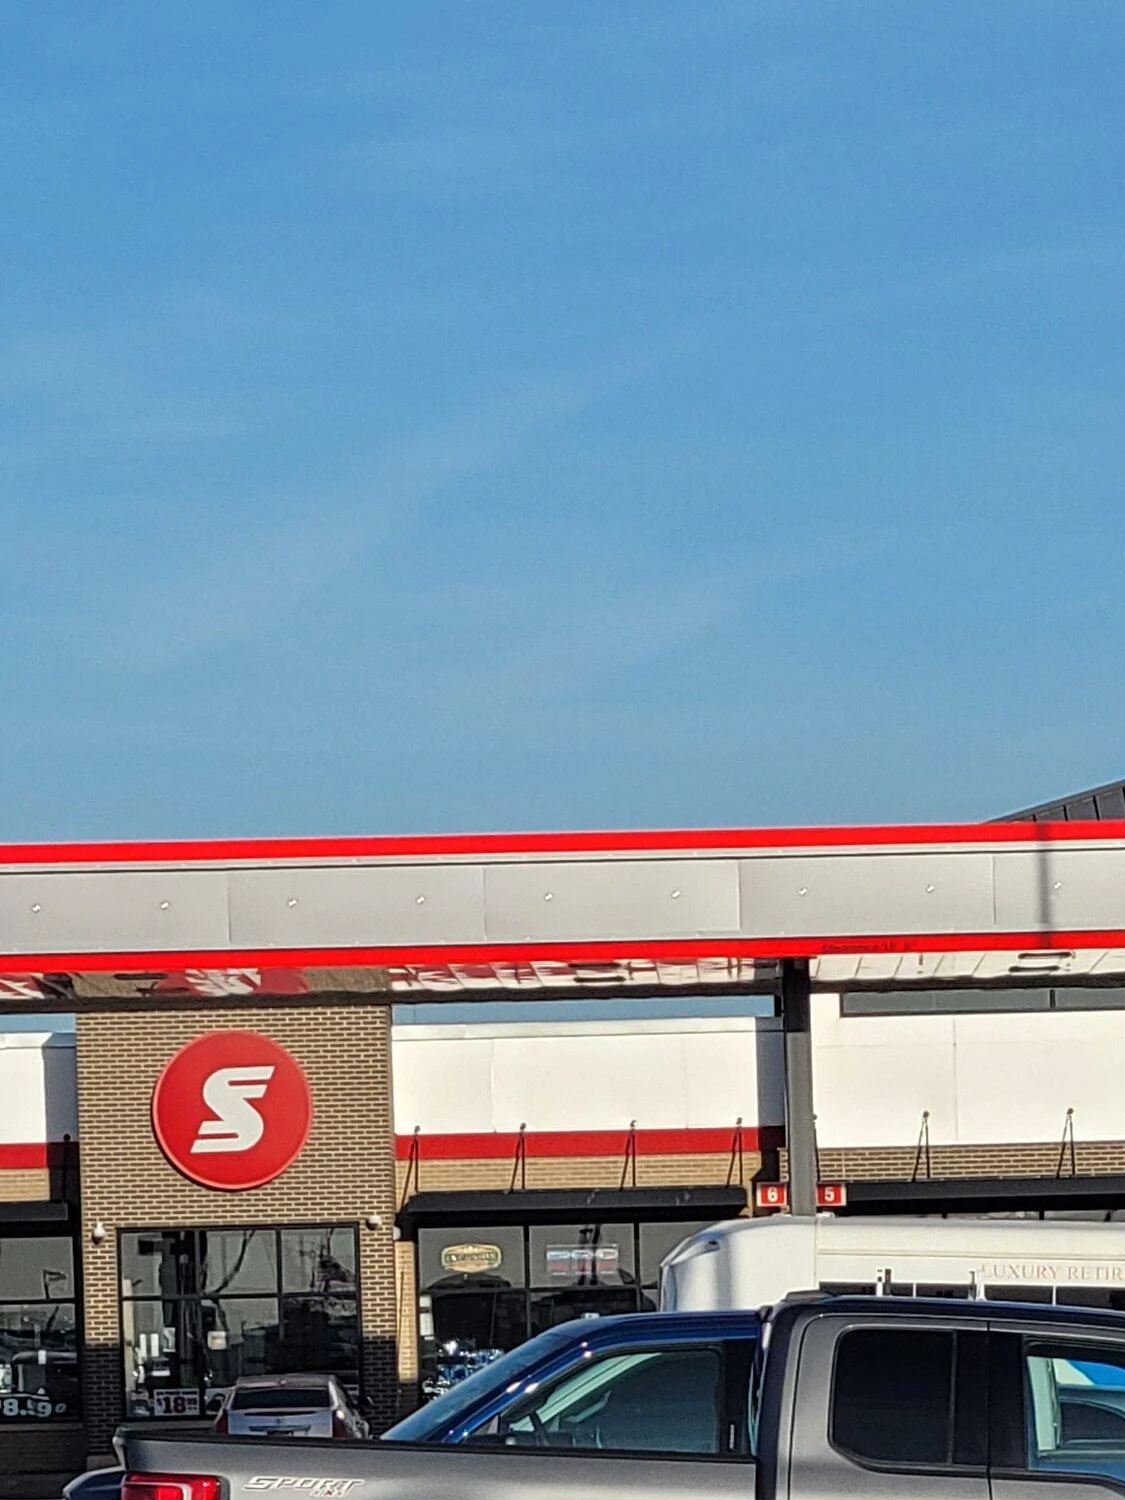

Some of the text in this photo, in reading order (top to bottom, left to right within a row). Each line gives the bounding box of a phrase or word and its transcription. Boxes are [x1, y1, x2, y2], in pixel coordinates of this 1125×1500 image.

[191, 1065, 275, 1153] S
[767, 1187, 778, 1202] 6
[824, 1187, 835, 1202] 5
[982, 1264, 1060, 1280] LUXURY
[243, 1475, 366, 1492] SPORT
